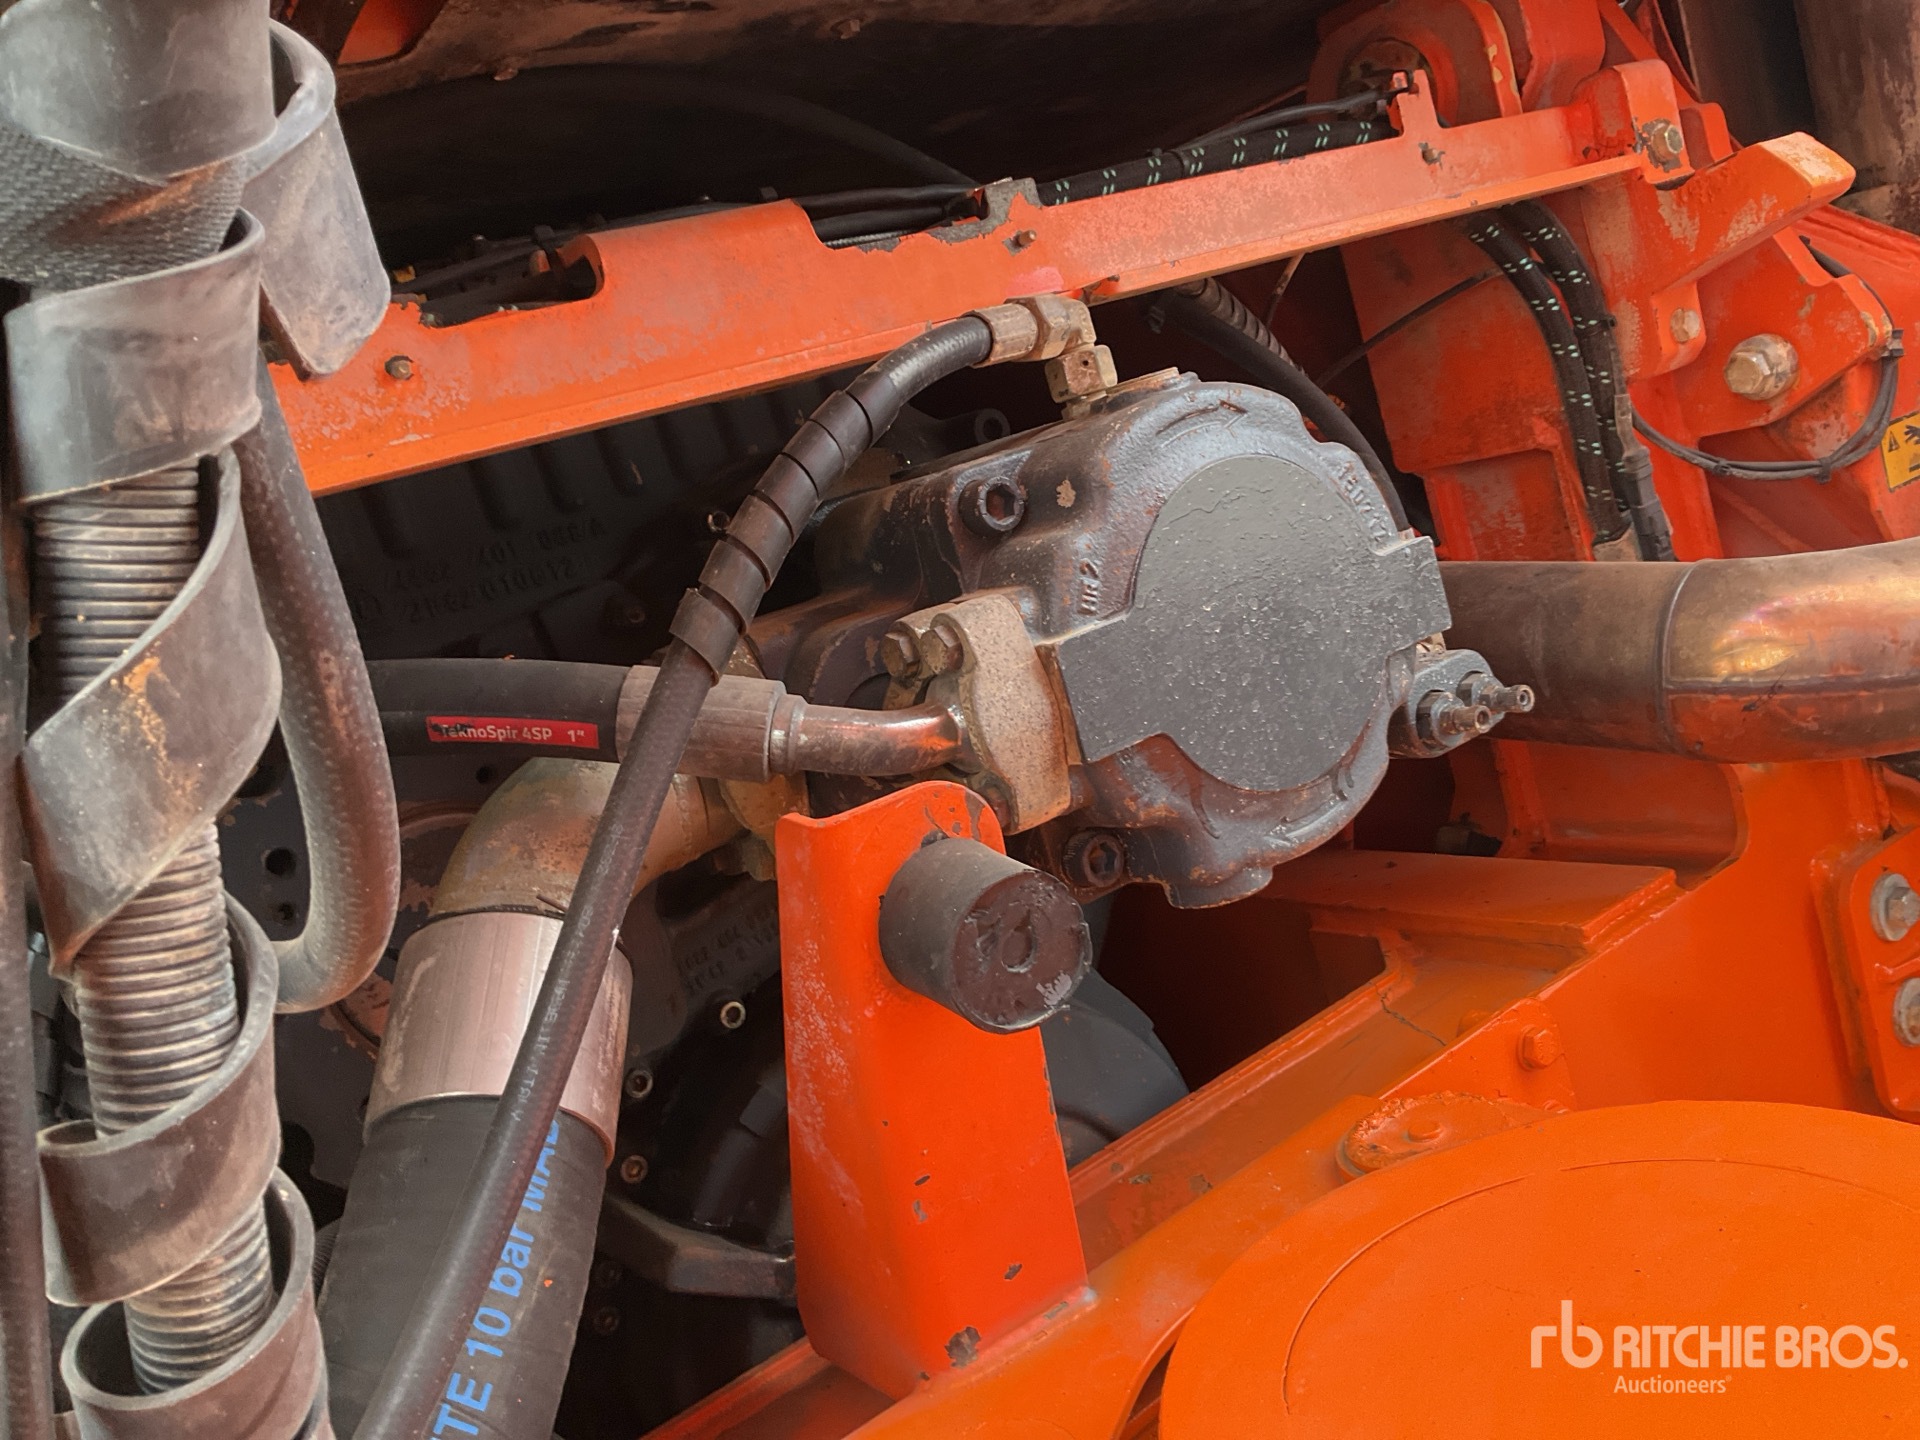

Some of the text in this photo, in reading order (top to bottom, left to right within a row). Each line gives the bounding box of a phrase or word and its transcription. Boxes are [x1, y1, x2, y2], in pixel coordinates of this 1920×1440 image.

[522, 726, 553, 741] 4SP
[429, 1372, 494, 1440] TE
[465, 1305, 512, 1358] 10
[489, 1222, 535, 1297] bar
